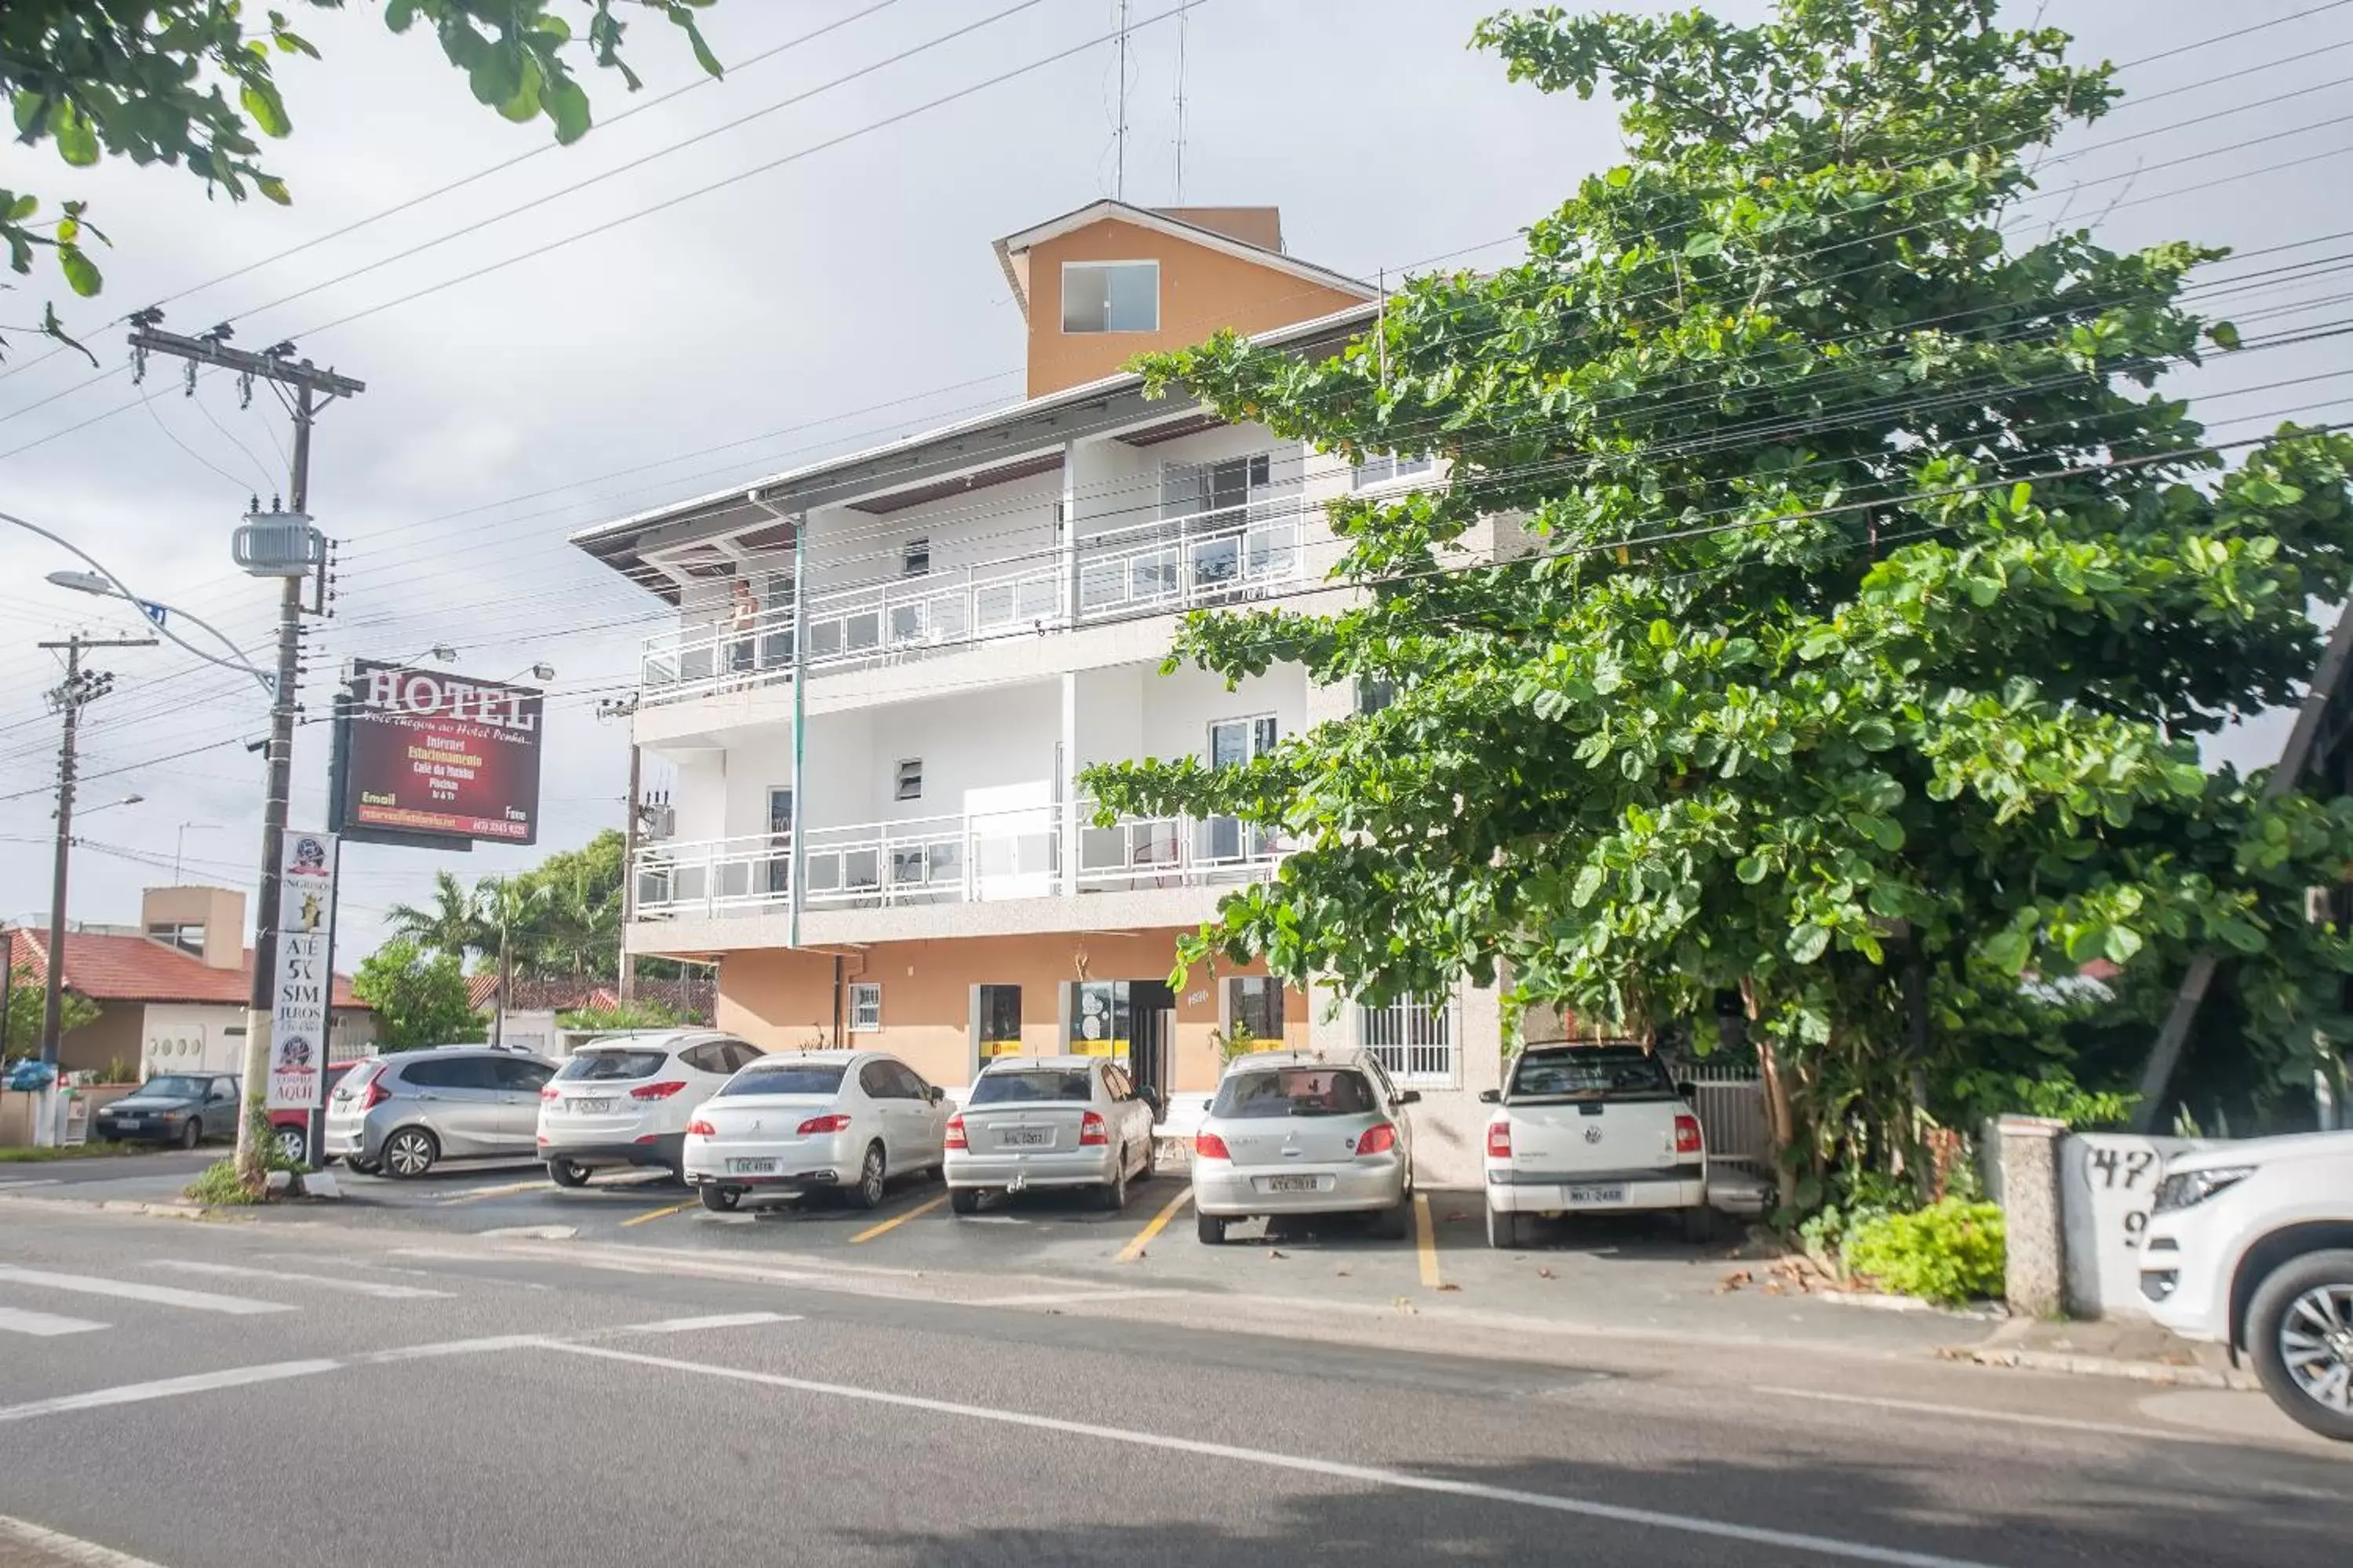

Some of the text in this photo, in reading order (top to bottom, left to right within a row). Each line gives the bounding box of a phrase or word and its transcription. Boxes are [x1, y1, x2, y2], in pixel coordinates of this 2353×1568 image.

[365, 668, 535, 731] HOTEL
[426, 735, 465, 751] Internet
[408, 745, 483, 768] Estacionamento
[361, 791, 396, 806] Email
[505, 805, 526, 821] Fone
[286, 936, 319, 955] ATÉ
